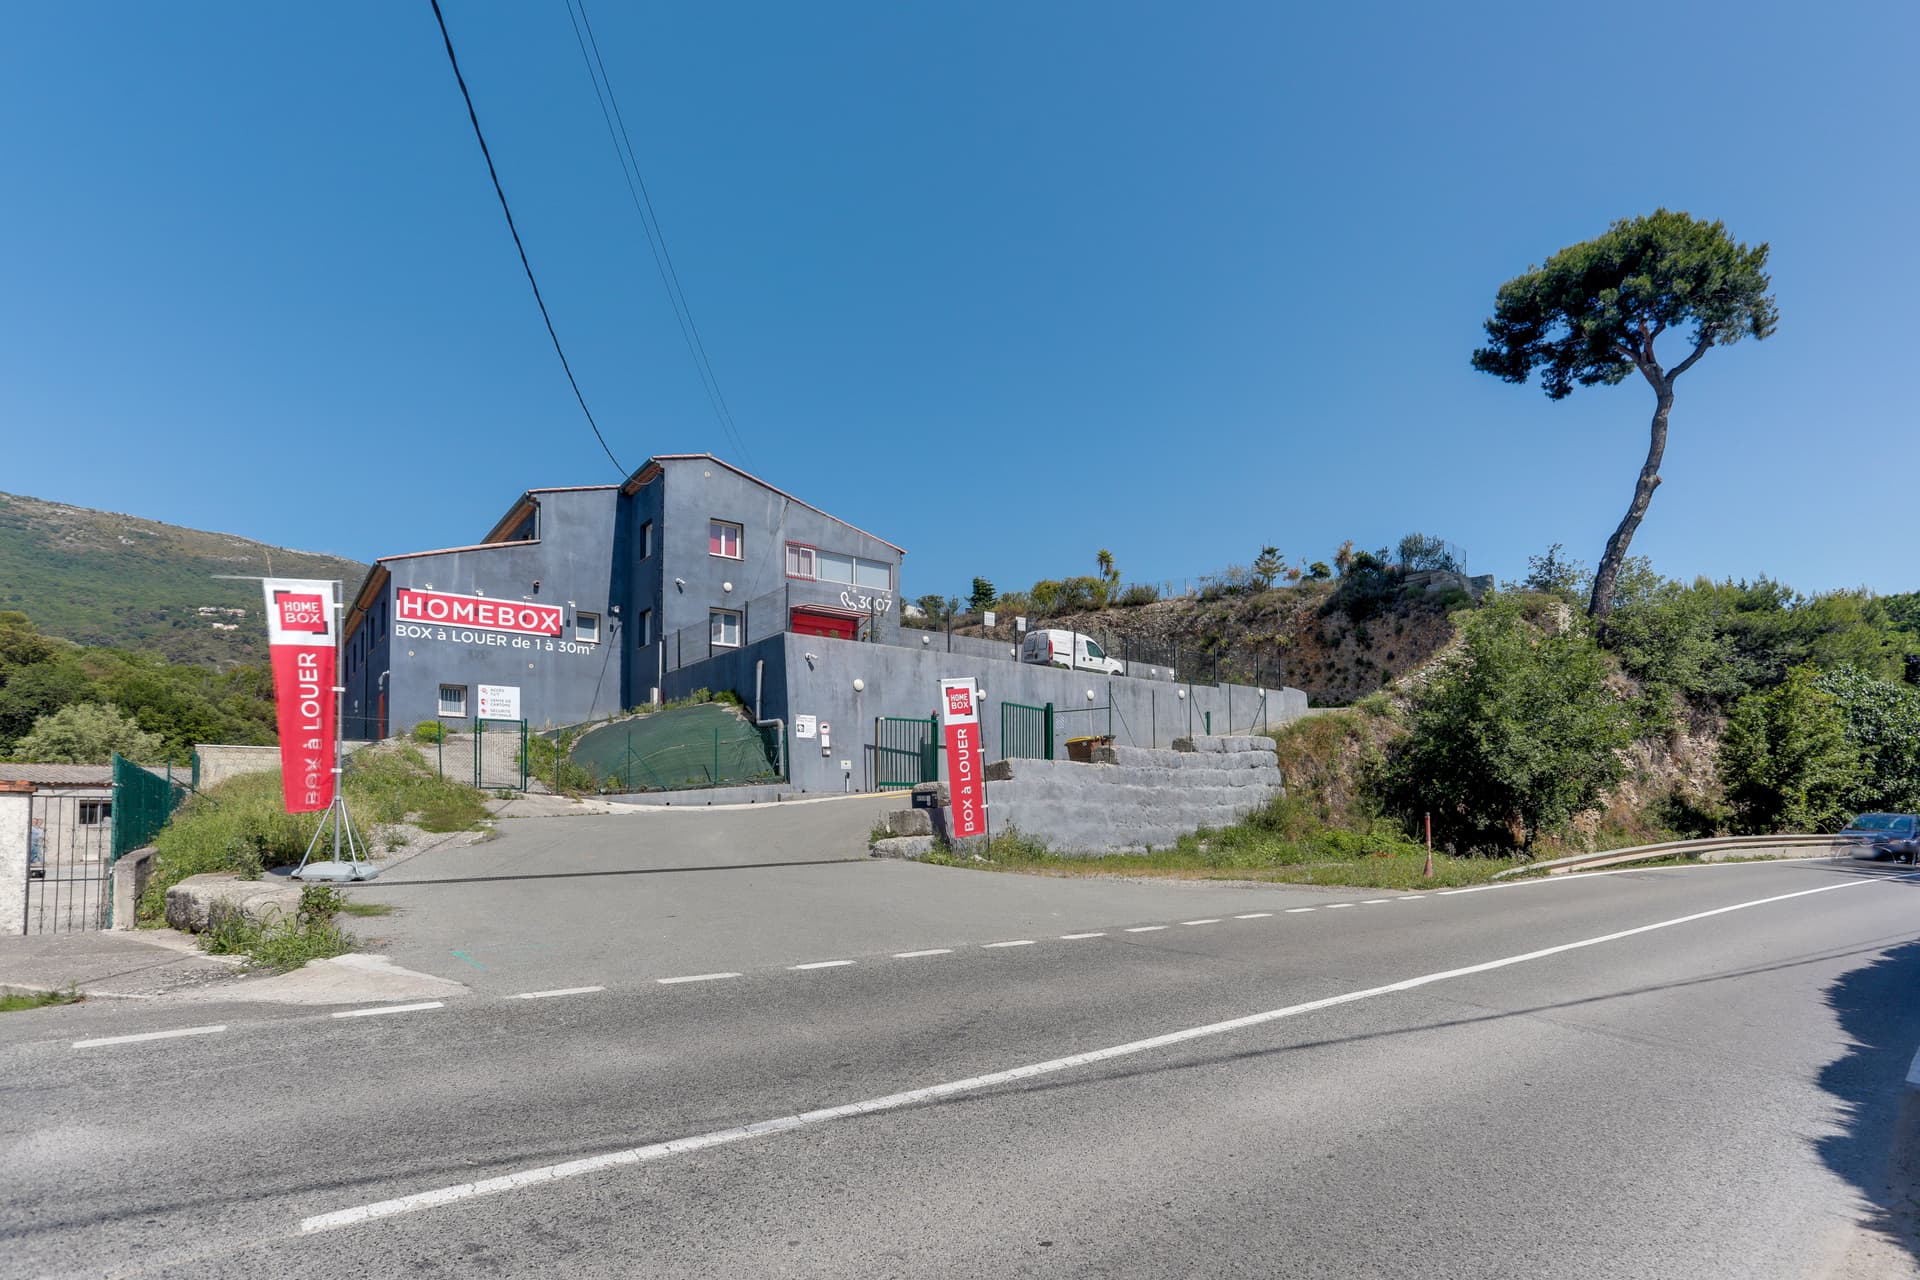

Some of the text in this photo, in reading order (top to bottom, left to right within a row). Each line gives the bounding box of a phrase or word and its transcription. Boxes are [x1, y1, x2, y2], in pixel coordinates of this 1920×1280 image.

[284, 600, 321, 612] HOME
[858, 595, 892, 611] 3007
[285, 612, 321, 624] BOX
[403, 595, 557, 631] HOMEBOX
[395, 624, 433, 639] BOX
[437, 628, 447, 641] à
[452, 630, 507, 647] LOUER
[512, 637, 531, 649] de
[545, 638, 553, 651] à
[297, 652, 321, 730] LOUER
[951, 692, 968, 702] HOME
[951, 701, 969, 710] BOX
[303, 738, 322, 750] à
[957, 728, 975, 832] BOX à LOUER
